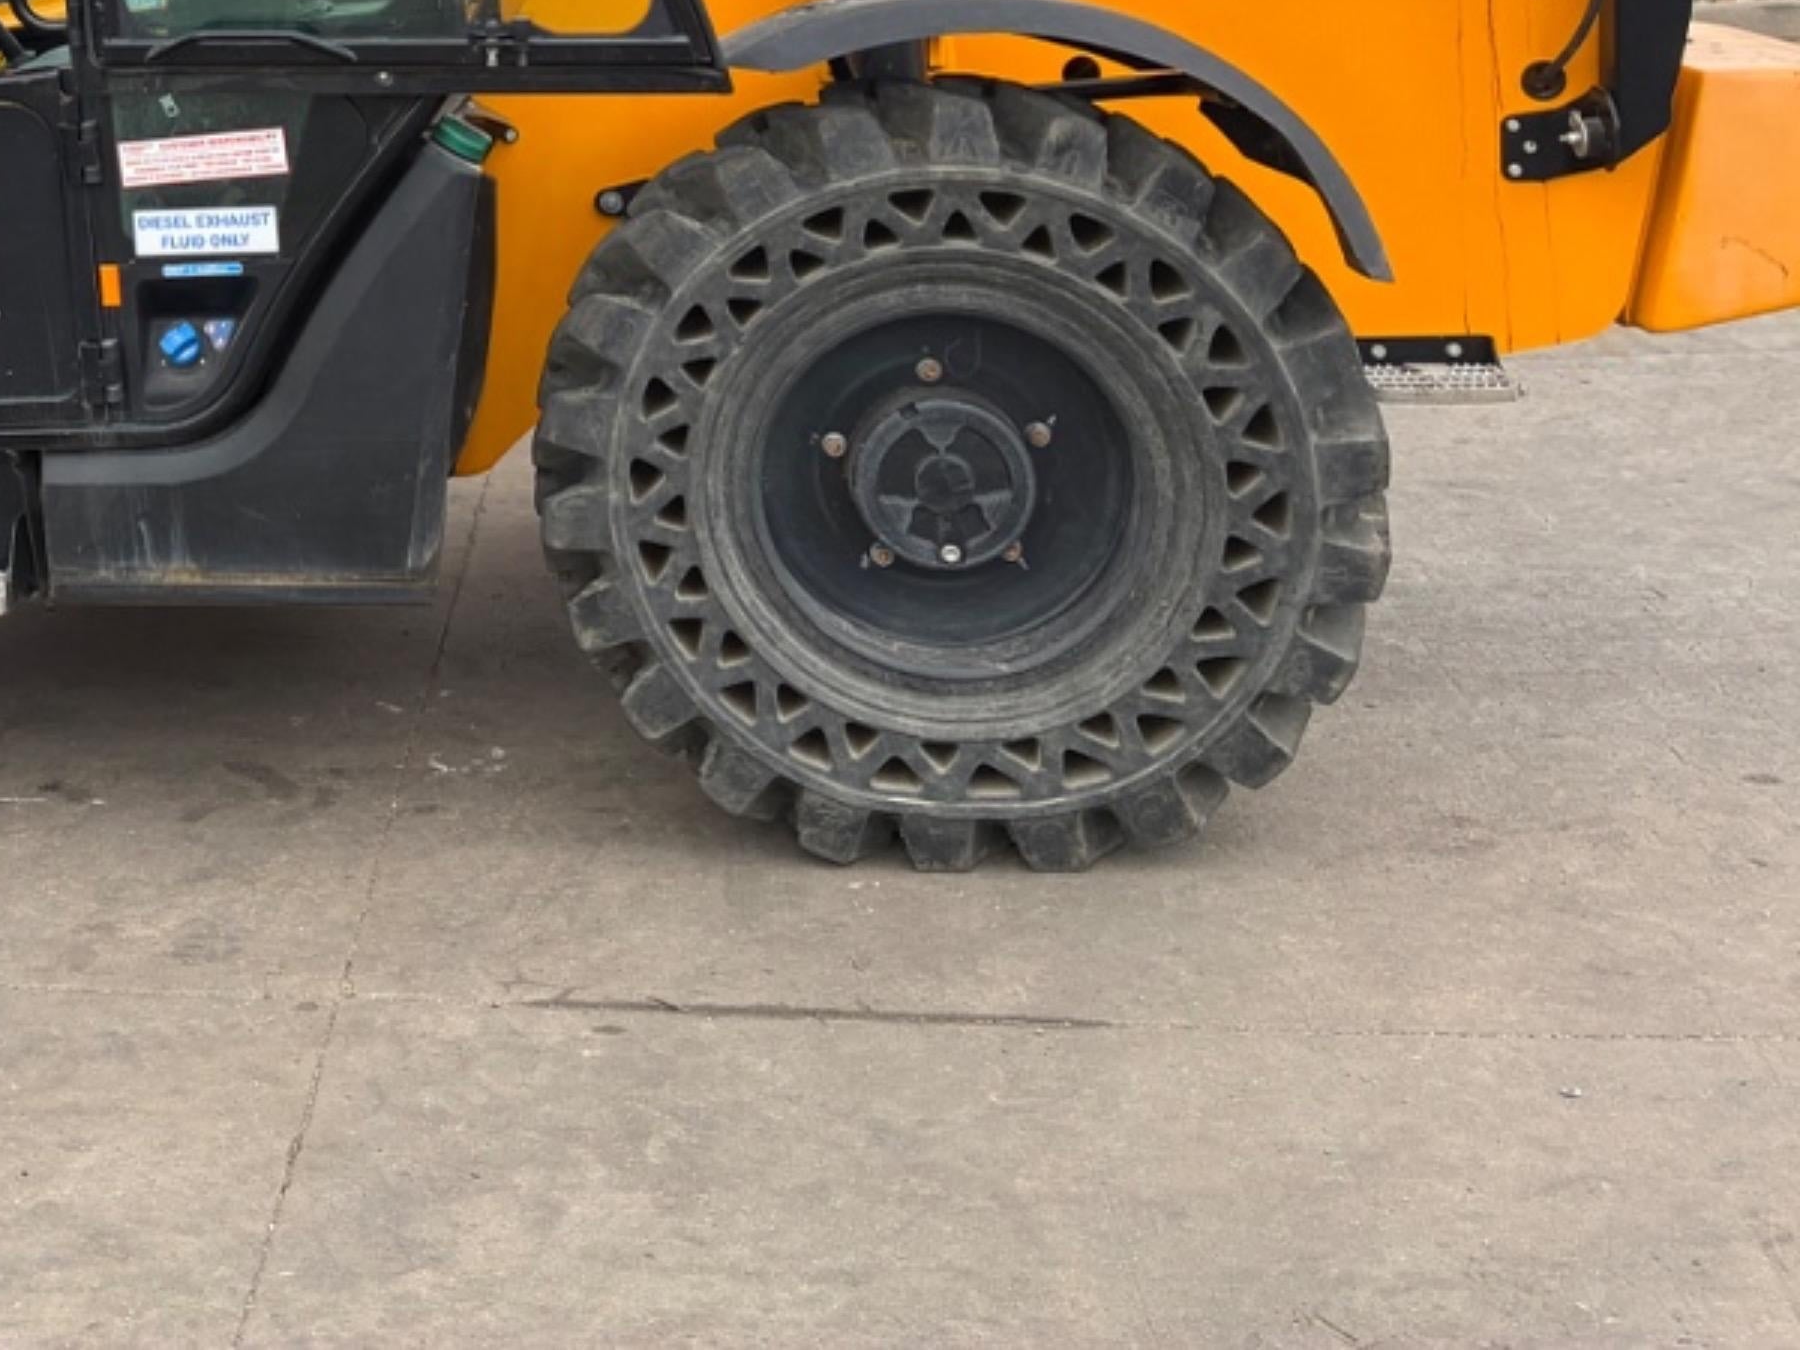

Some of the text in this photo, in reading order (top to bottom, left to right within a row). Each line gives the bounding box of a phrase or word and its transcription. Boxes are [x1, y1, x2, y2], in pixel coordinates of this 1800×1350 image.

[138, 212, 271, 230] DIESEL EXHAUST
[160, 232, 251, 250] FLUID ONLY
